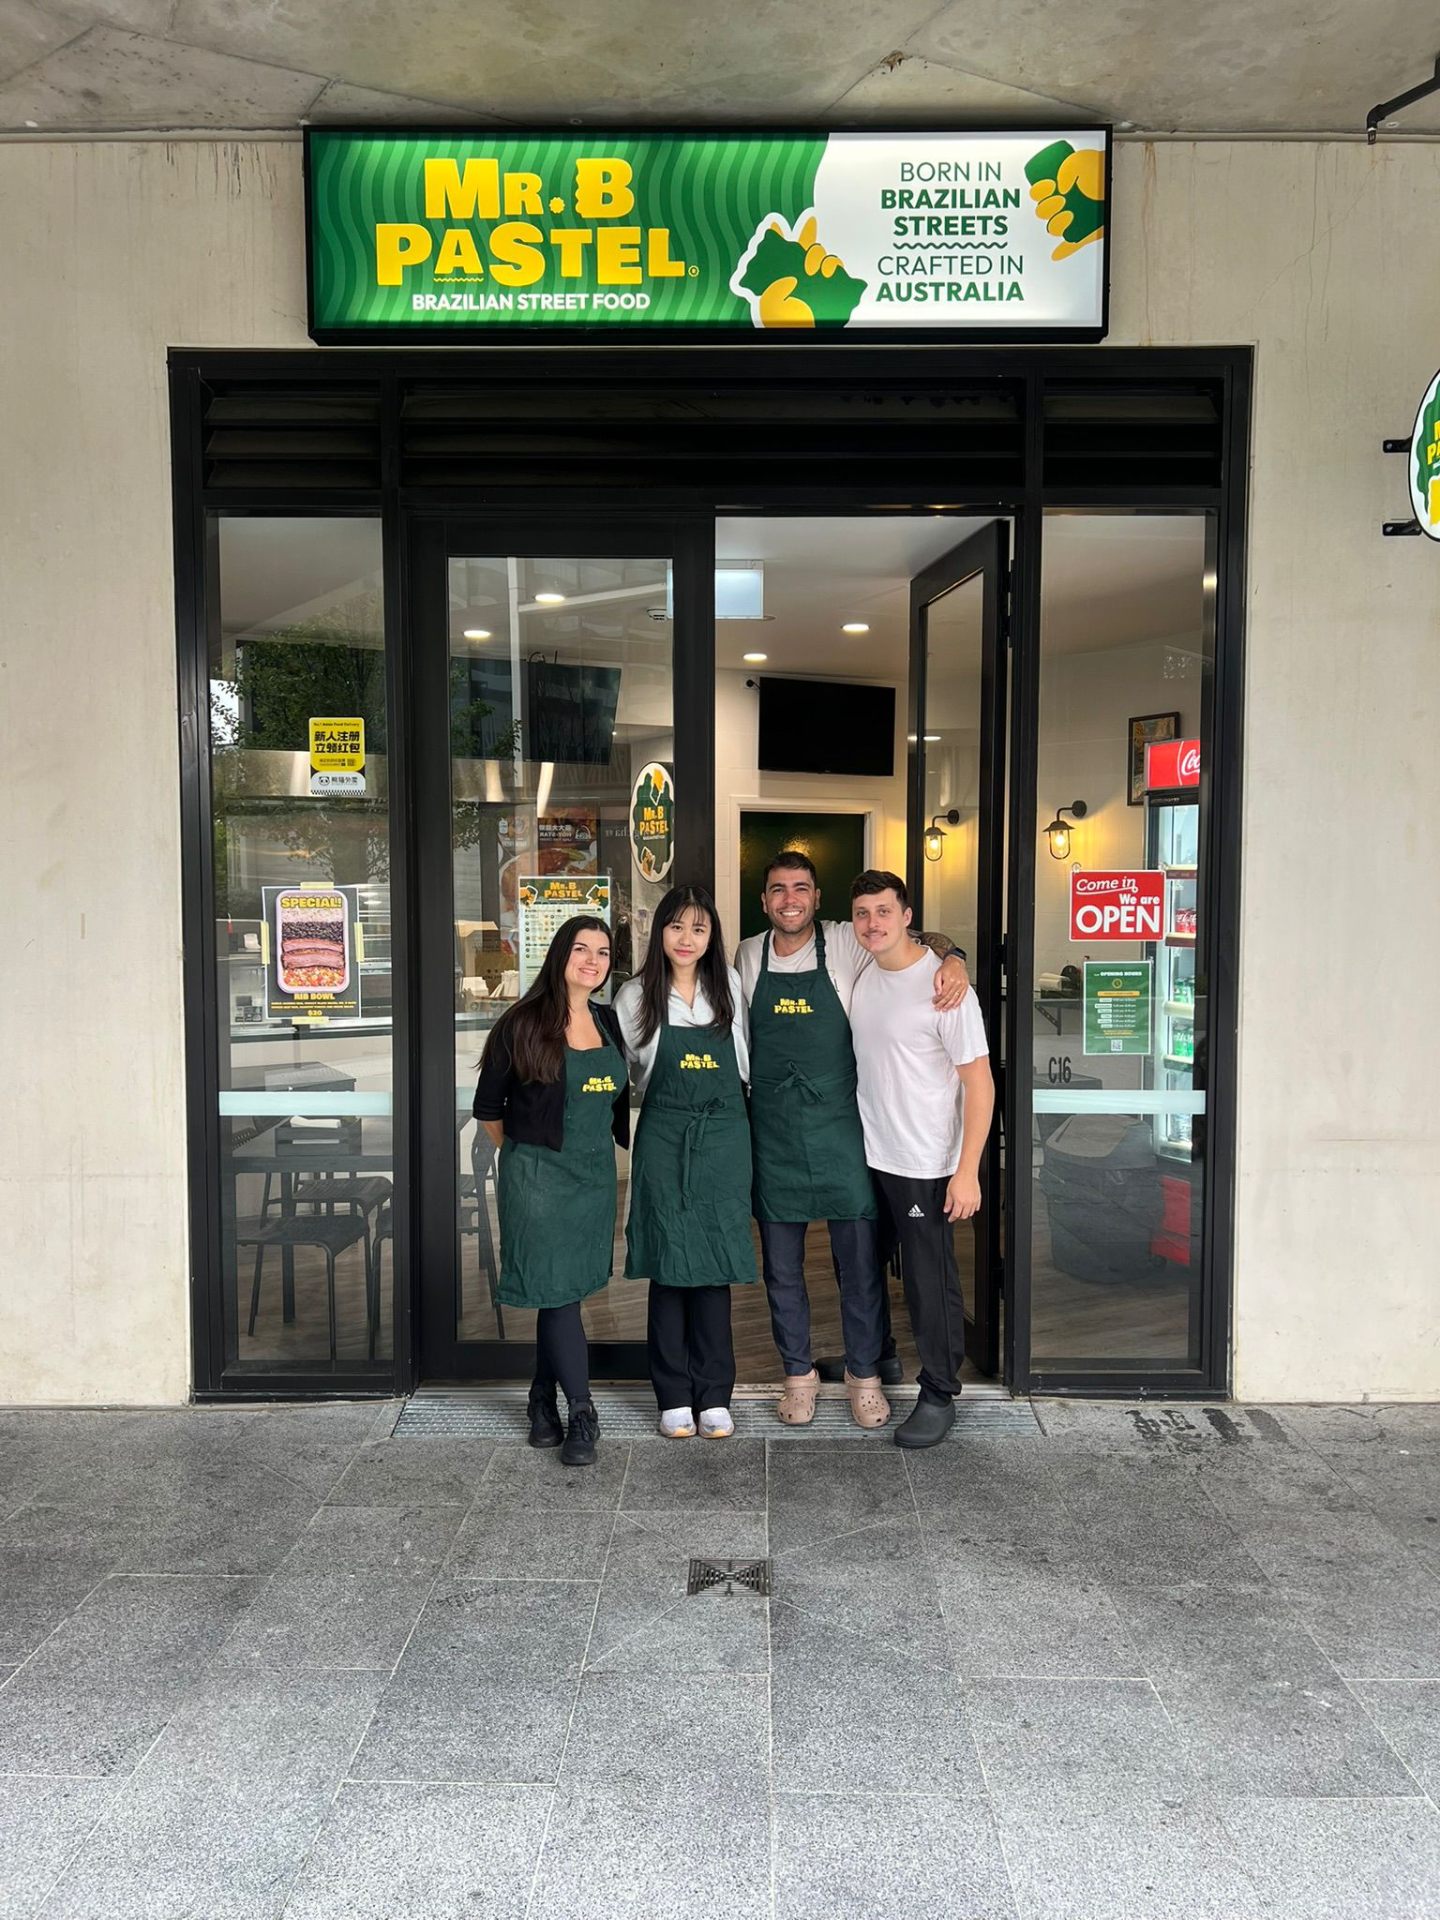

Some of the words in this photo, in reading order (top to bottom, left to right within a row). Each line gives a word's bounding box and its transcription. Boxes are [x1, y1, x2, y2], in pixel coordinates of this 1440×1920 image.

[900, 162, 971, 182] BORN
[978, 161, 1001, 181] IN
[881, 188, 1020, 209] BRAZILIAN
[893, 215, 1008, 237] STREETS
[376, 222, 686, 286] PASTEL
[877, 255, 992, 276] CRAFTED
[999, 255, 1024, 275] IN
[876, 281, 1024, 302] AUSTRALIA
[412, 293, 513, 311] BRAZILIAN
[517, 293, 589, 311] STREET
[593, 293, 650, 310] FOOD
[314, 731, 360, 742] 新人注册
[544, 890, 583, 898] PASTEL
[1076, 879, 1119, 892] Come
[1121, 876, 1139, 893] in
[281, 896, 342, 908] SPECIAL!
[1119, 893, 1138, 905] We
[1140, 896, 1160, 905] are
[1076, 905, 1160, 933] OPEN
[774, 1005, 814, 1014] PASTEL
[680, 1060, 720, 1069] PASTEL
[1049, 1056, 1071, 1084] C16
